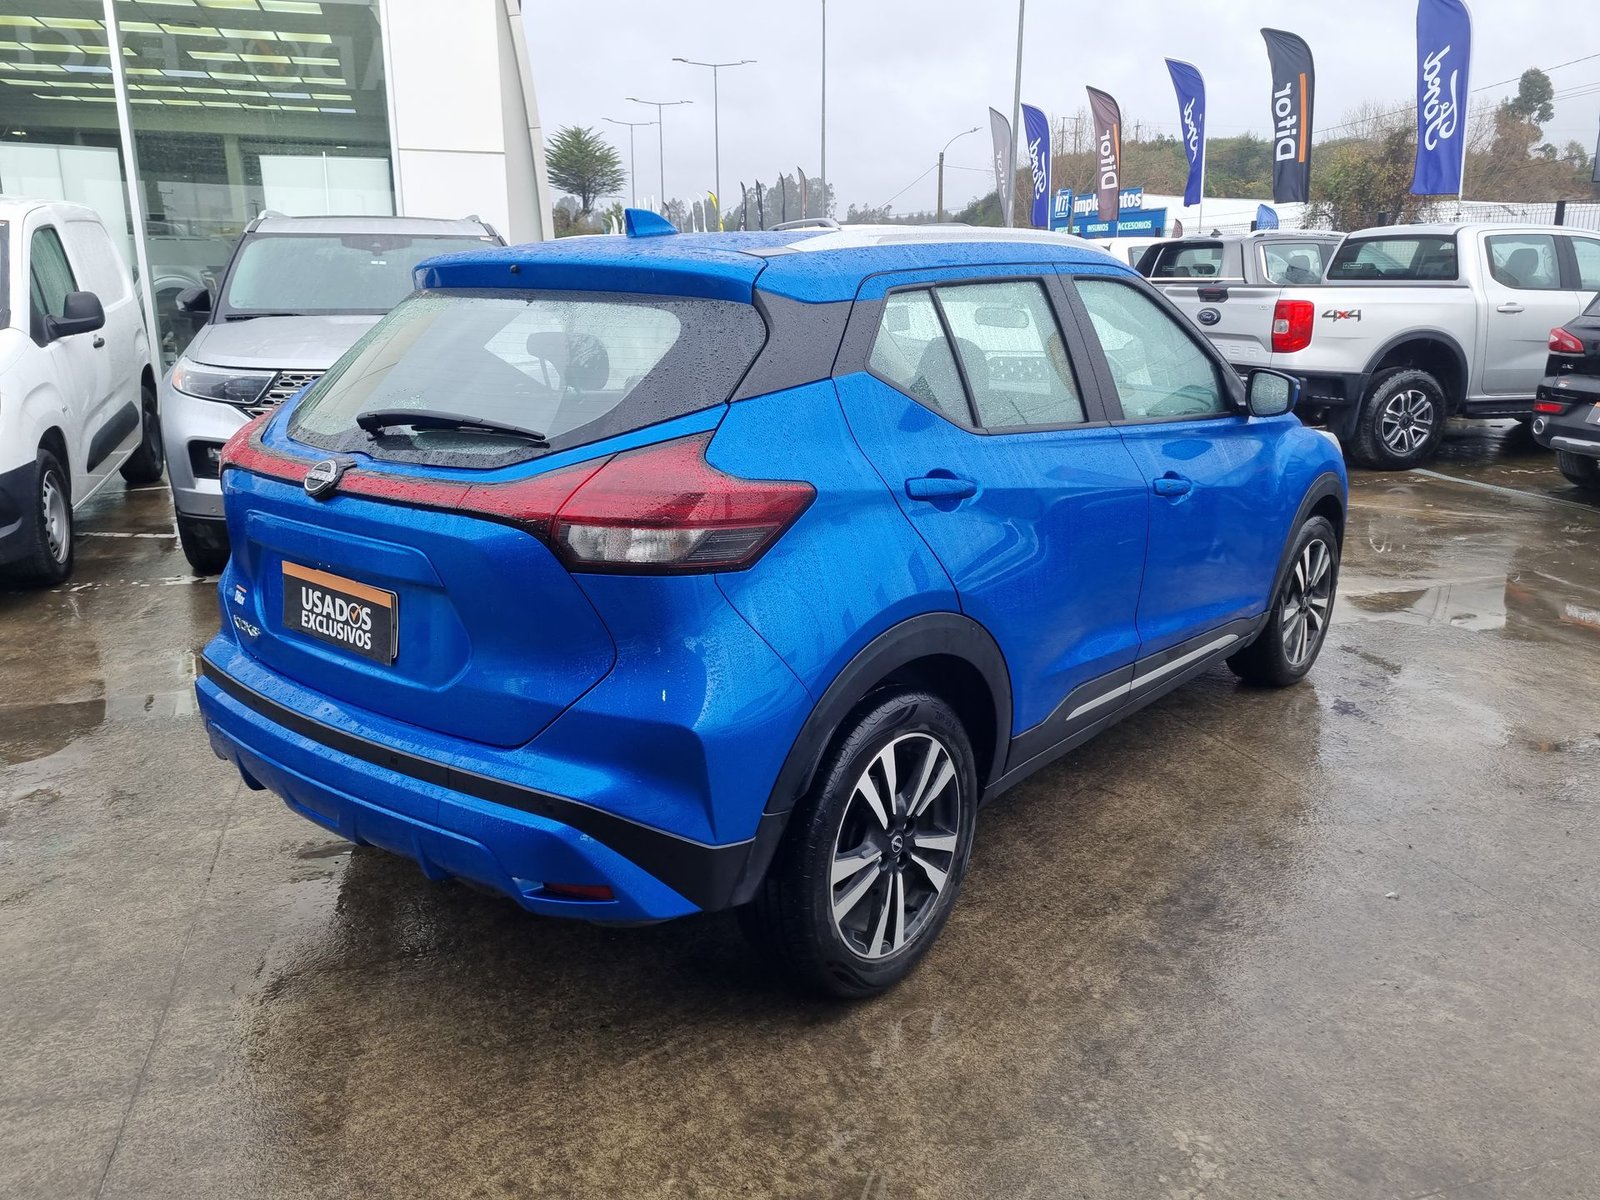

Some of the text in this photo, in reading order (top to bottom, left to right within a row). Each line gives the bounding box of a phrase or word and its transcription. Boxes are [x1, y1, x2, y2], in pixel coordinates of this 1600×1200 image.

[1118, 220, 1152, 231] ACCESORIOS
[1321, 309, 1362, 322] 4x4
[301, 586, 372, 631] USADOS
[301, 609, 372, 650] EXCLUSIVOS
